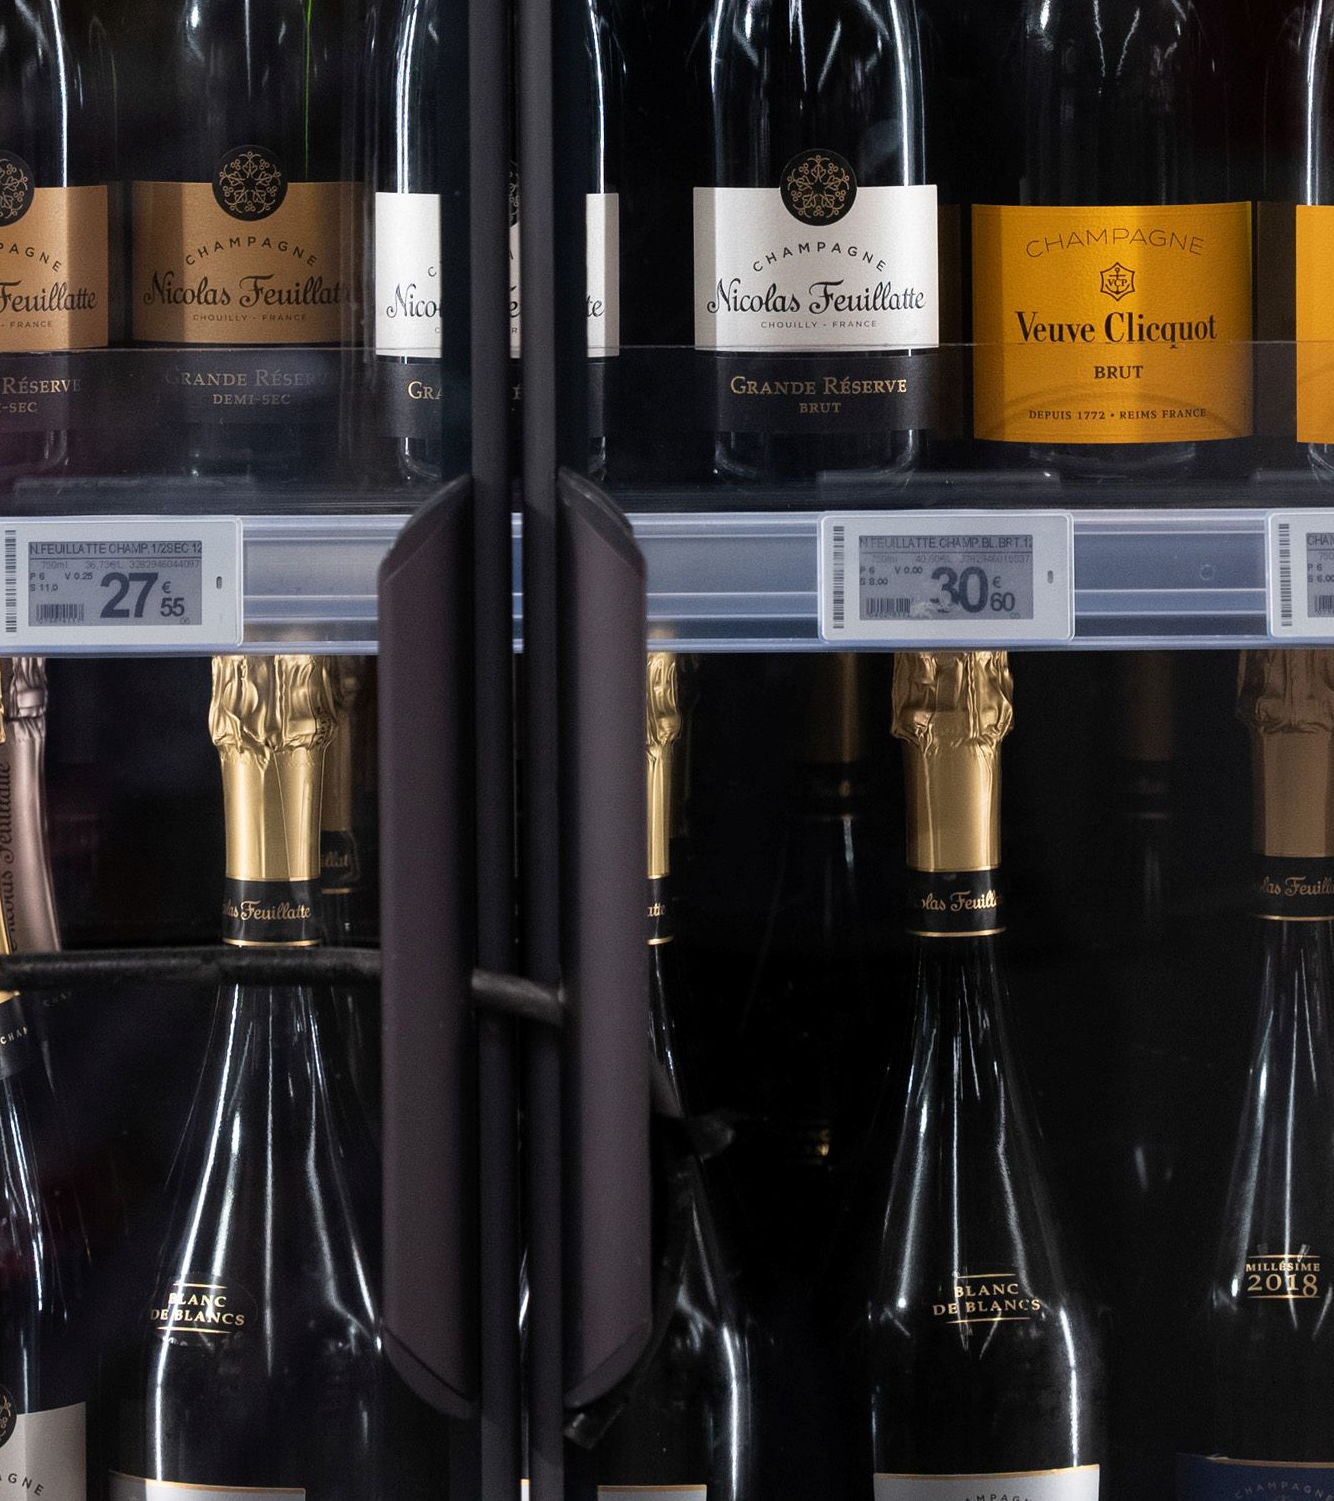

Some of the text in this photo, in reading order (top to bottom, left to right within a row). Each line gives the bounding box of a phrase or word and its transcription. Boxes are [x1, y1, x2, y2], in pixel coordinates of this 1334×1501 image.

[185, 236, 317, 267] CHAMPAGNE
[753, 241, 887, 273] CHAMPAGNE
[144, 271, 230, 307] Nicolas
[706, 277, 926, 315] Nicolas Feuillatte
[1015, 310, 1217, 349] Veuve Clicquot
[1094, 366, 1143, 379] BRUT
[2, 376, 82, 394] RÉSERVE
[731, 376, 907, 396] GRANDE RÉSERVE
[213, 393, 292, 406] DEMI-SEC
[1029, 408, 1207, 420] DEPUIS REIMS FRANCE
[99, 572, 186, 619] 27 55
[930, 565, 1015, 613] 30 60
[954, 1283, 1018, 1298] BLANC
[1247, 1273, 1318, 1298] 2018
[168, 1293, 227, 1307] BLANC
[959, 1298, 1042, 1315] BLANCS
[173, 1309, 245, 1326] BLANCS
